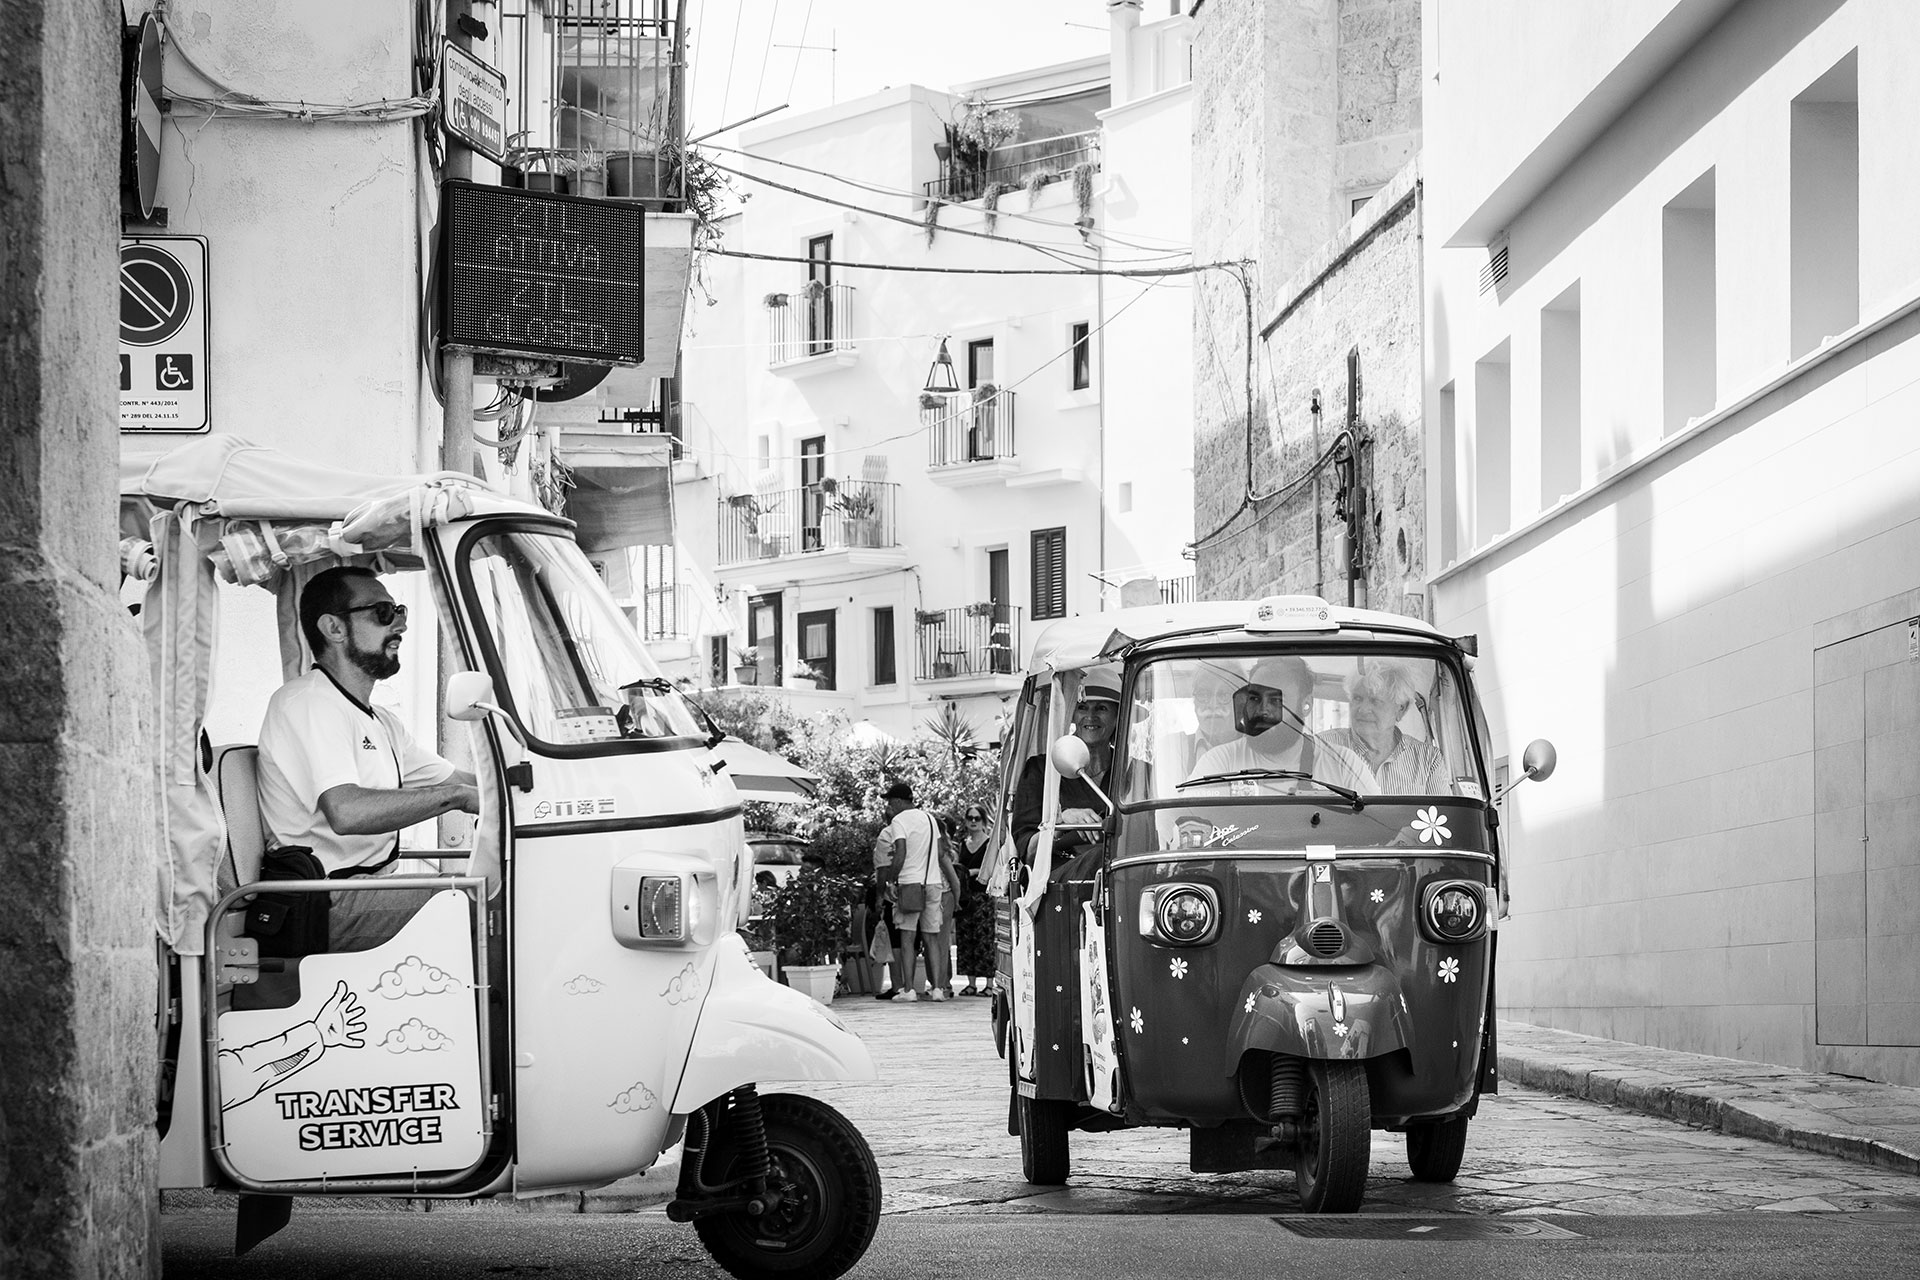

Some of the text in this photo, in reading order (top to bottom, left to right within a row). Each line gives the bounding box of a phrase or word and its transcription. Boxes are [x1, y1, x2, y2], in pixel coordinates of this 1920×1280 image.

[458, 82, 493, 116] degli accessi
[513, 199, 579, 234] ZTL
[495, 234, 600, 270] ATTIVA
[513, 278, 579, 313] ZTL
[486, 313, 608, 349] CLOSED
[1209, 824, 1236, 841] Ape
[275, 1083, 461, 1120] TRANSFER
[299, 1116, 442, 1151] SERVICE
